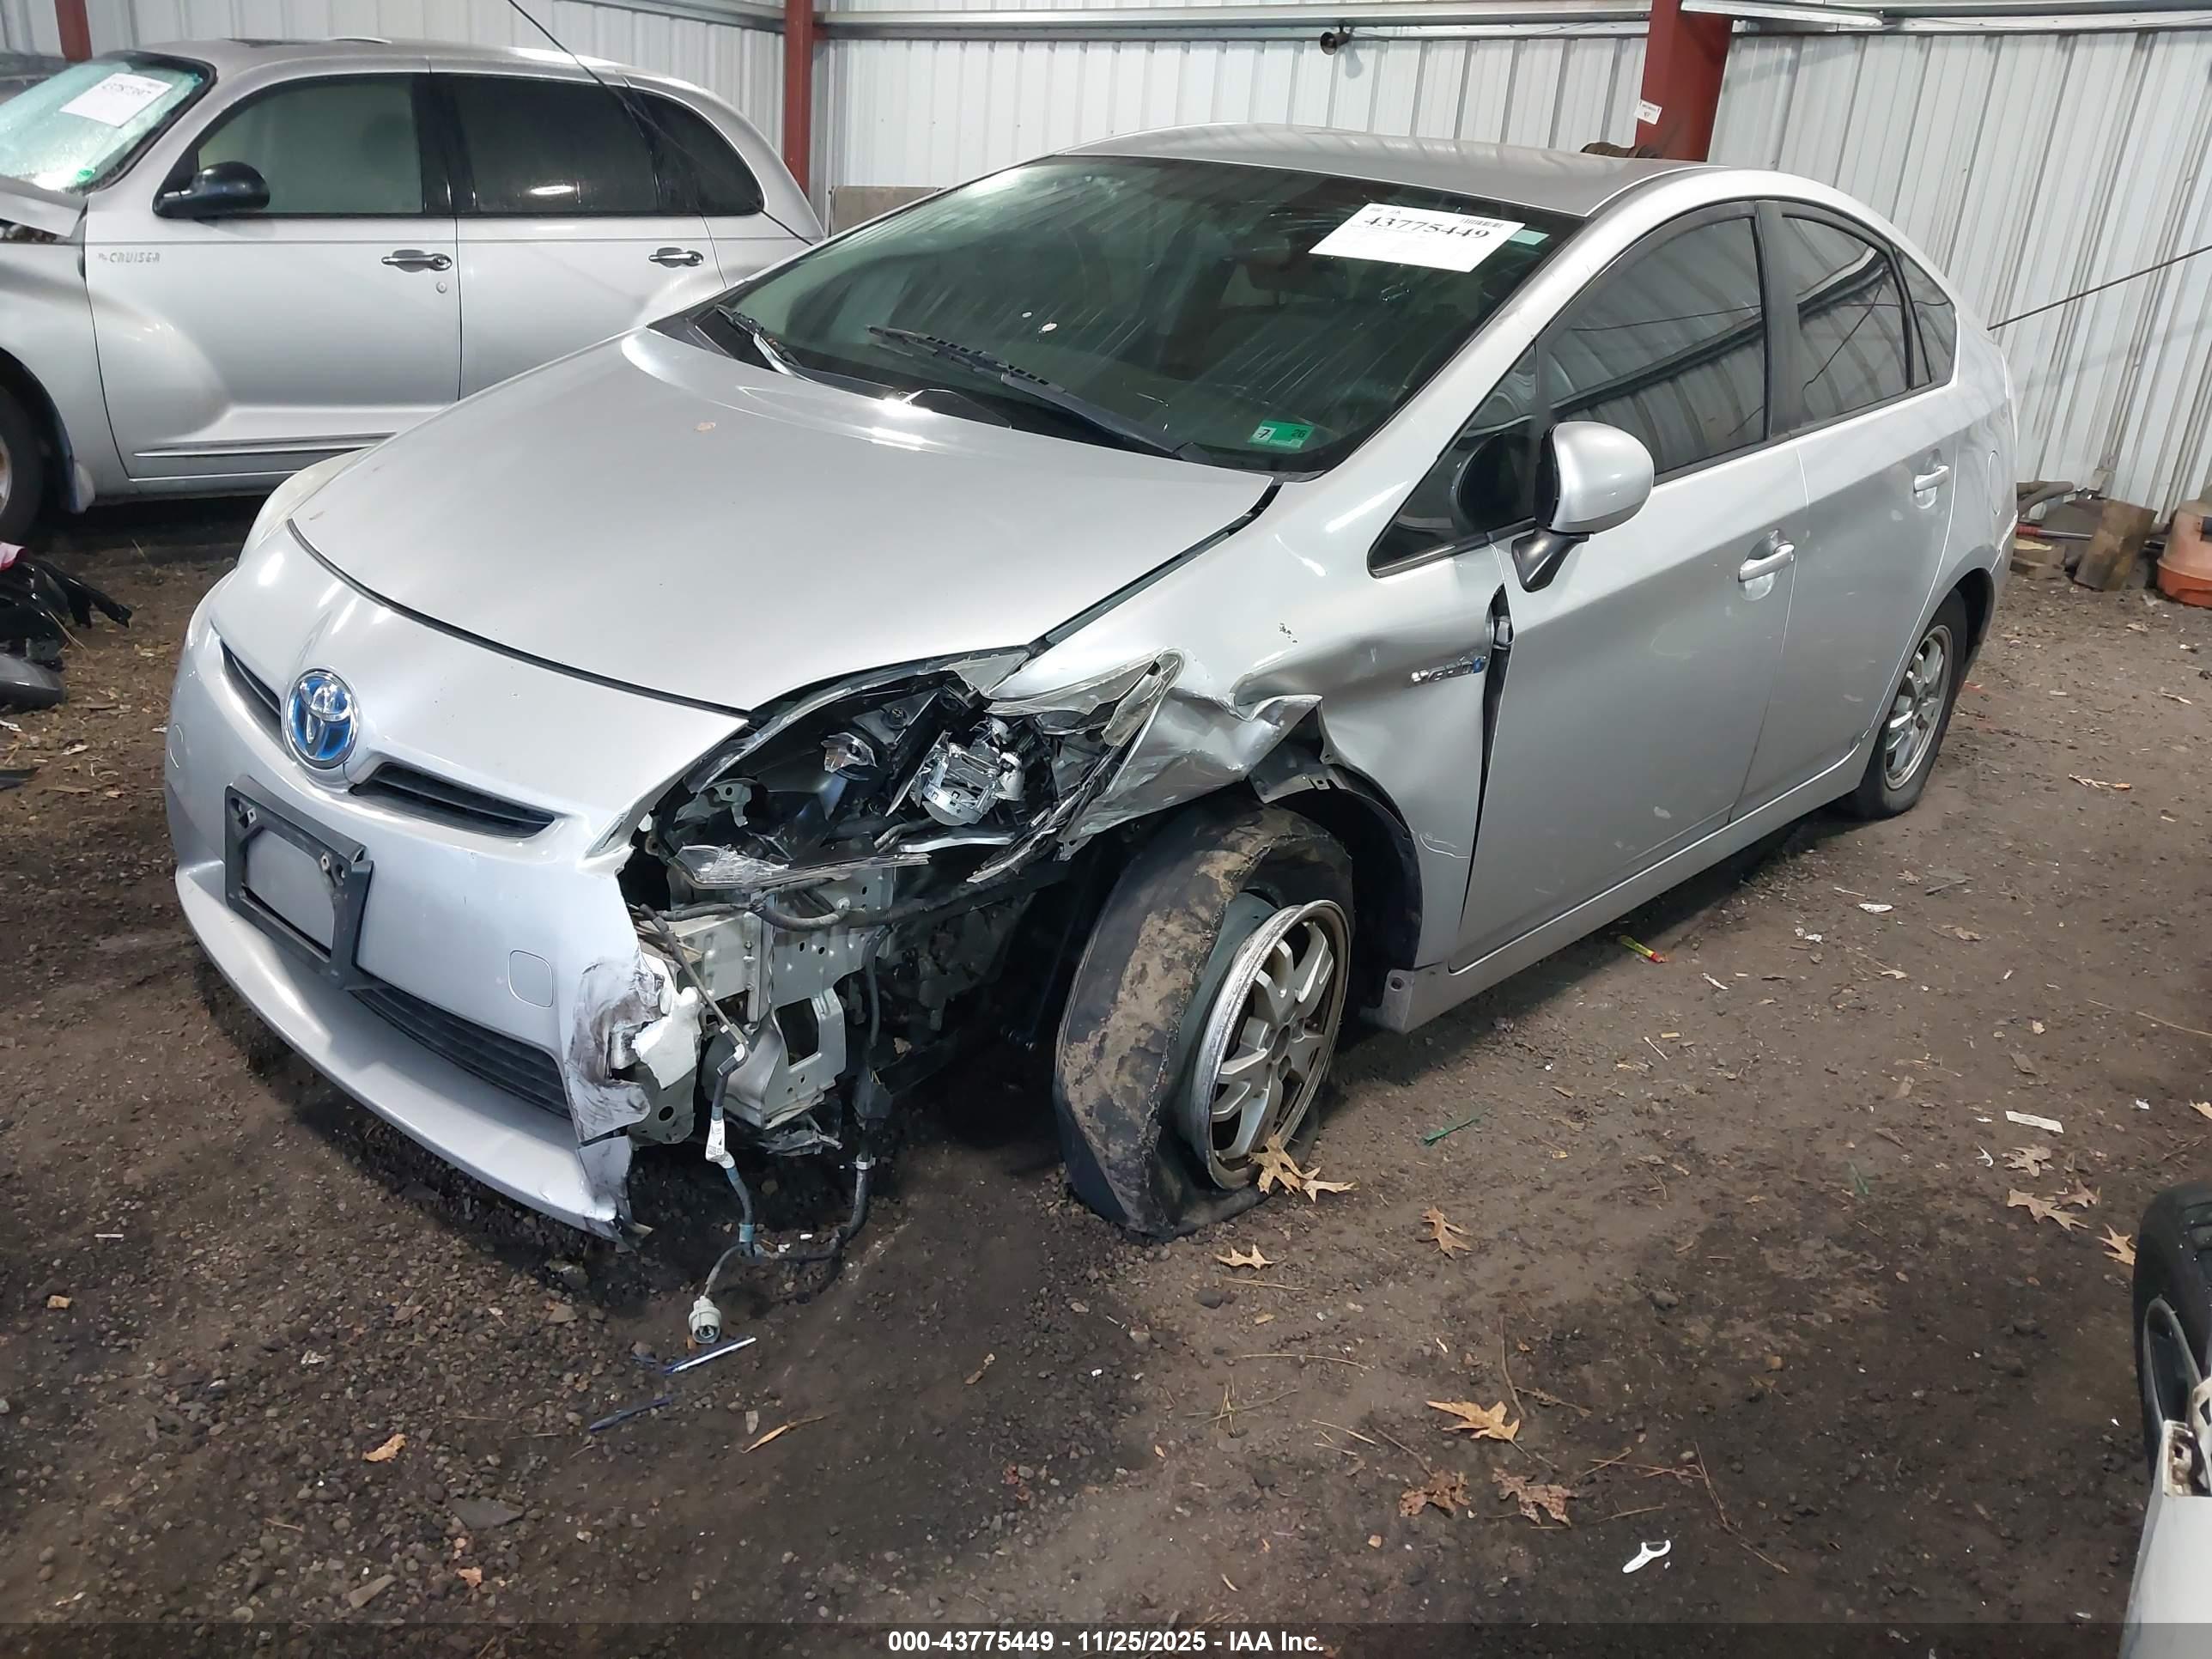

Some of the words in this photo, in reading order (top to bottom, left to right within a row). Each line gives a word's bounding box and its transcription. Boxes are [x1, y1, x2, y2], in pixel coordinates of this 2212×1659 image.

[1364, 216, 1490, 238] 43775449
[110, 252, 161, 263] CRUISER
[1291, 429, 1307, 439] 26
